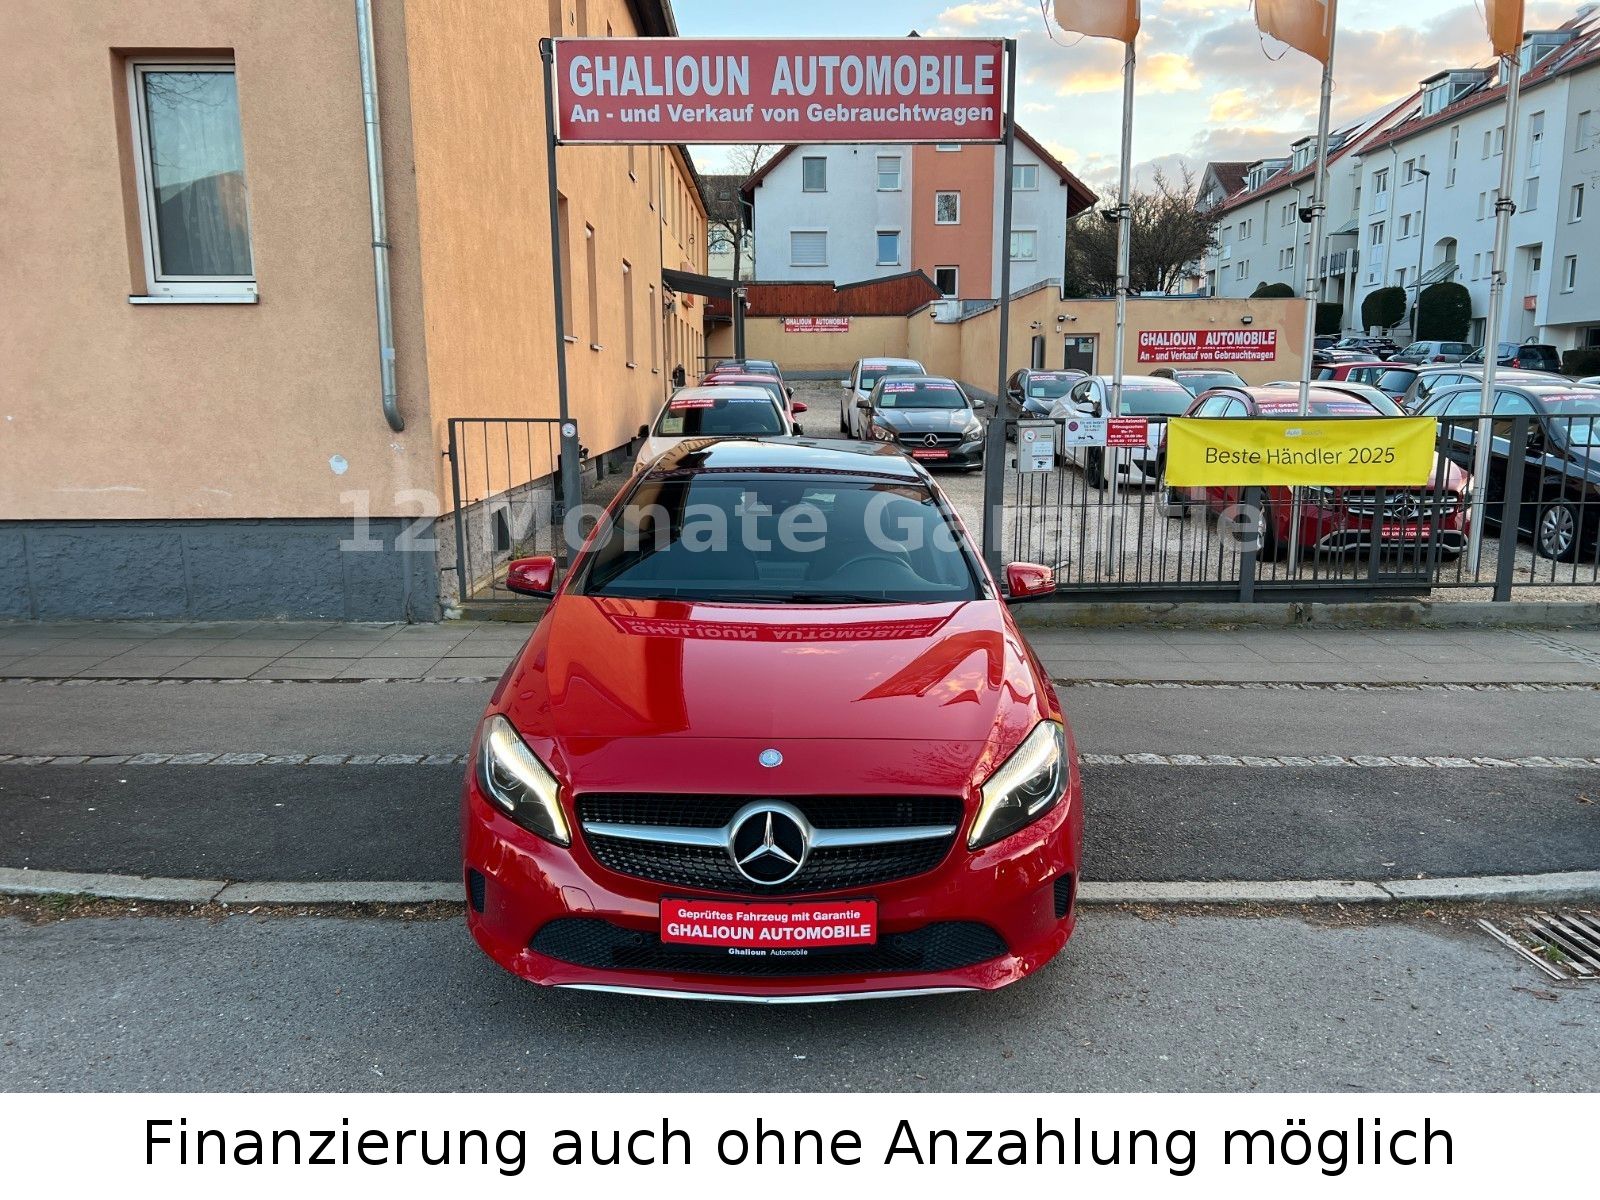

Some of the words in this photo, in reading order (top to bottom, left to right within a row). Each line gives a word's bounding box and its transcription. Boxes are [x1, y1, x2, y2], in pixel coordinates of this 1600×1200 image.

[569, 55, 750, 97] GHALIOUN
[770, 55, 994, 97] AUTOMOBILE
[570, 104, 600, 123] An
[620, 103, 661, 123] und
[666, 103, 755, 123] Verkauf
[760, 107, 800, 123] von
[806, 103, 994, 127] Gebrauchtwagen
[1140, 332, 1197, 346] GHALIOUN
[1205, 331, 1276, 345] AUTOMOBILE
[1140, 351, 1150, 360] An
[1156, 351, 1169, 360] und
[1171, 350, 1199, 360] Verkauf
[1200, 352, 1213, 360] von
[1214, 350, 1274, 361] Gebrauchtwagen
[1205, 447, 1261, 465] Beste
[1267, 448, 1343, 465] Händler
[1348, 447, 1396, 464] 2025
[677, 908, 734, 921] Geprüftes
[736, 911, 789, 923] Fahrzeug
[791, 911, 810, 921] mit
[812, 909, 861, 921] Garantie
[667, 922, 754, 940] GHALIOUN
[758, 924, 872, 941] AUTOMOBILE
[728, 947, 767, 956] Ghalioun
[769, 948, 808, 956] Automobile
